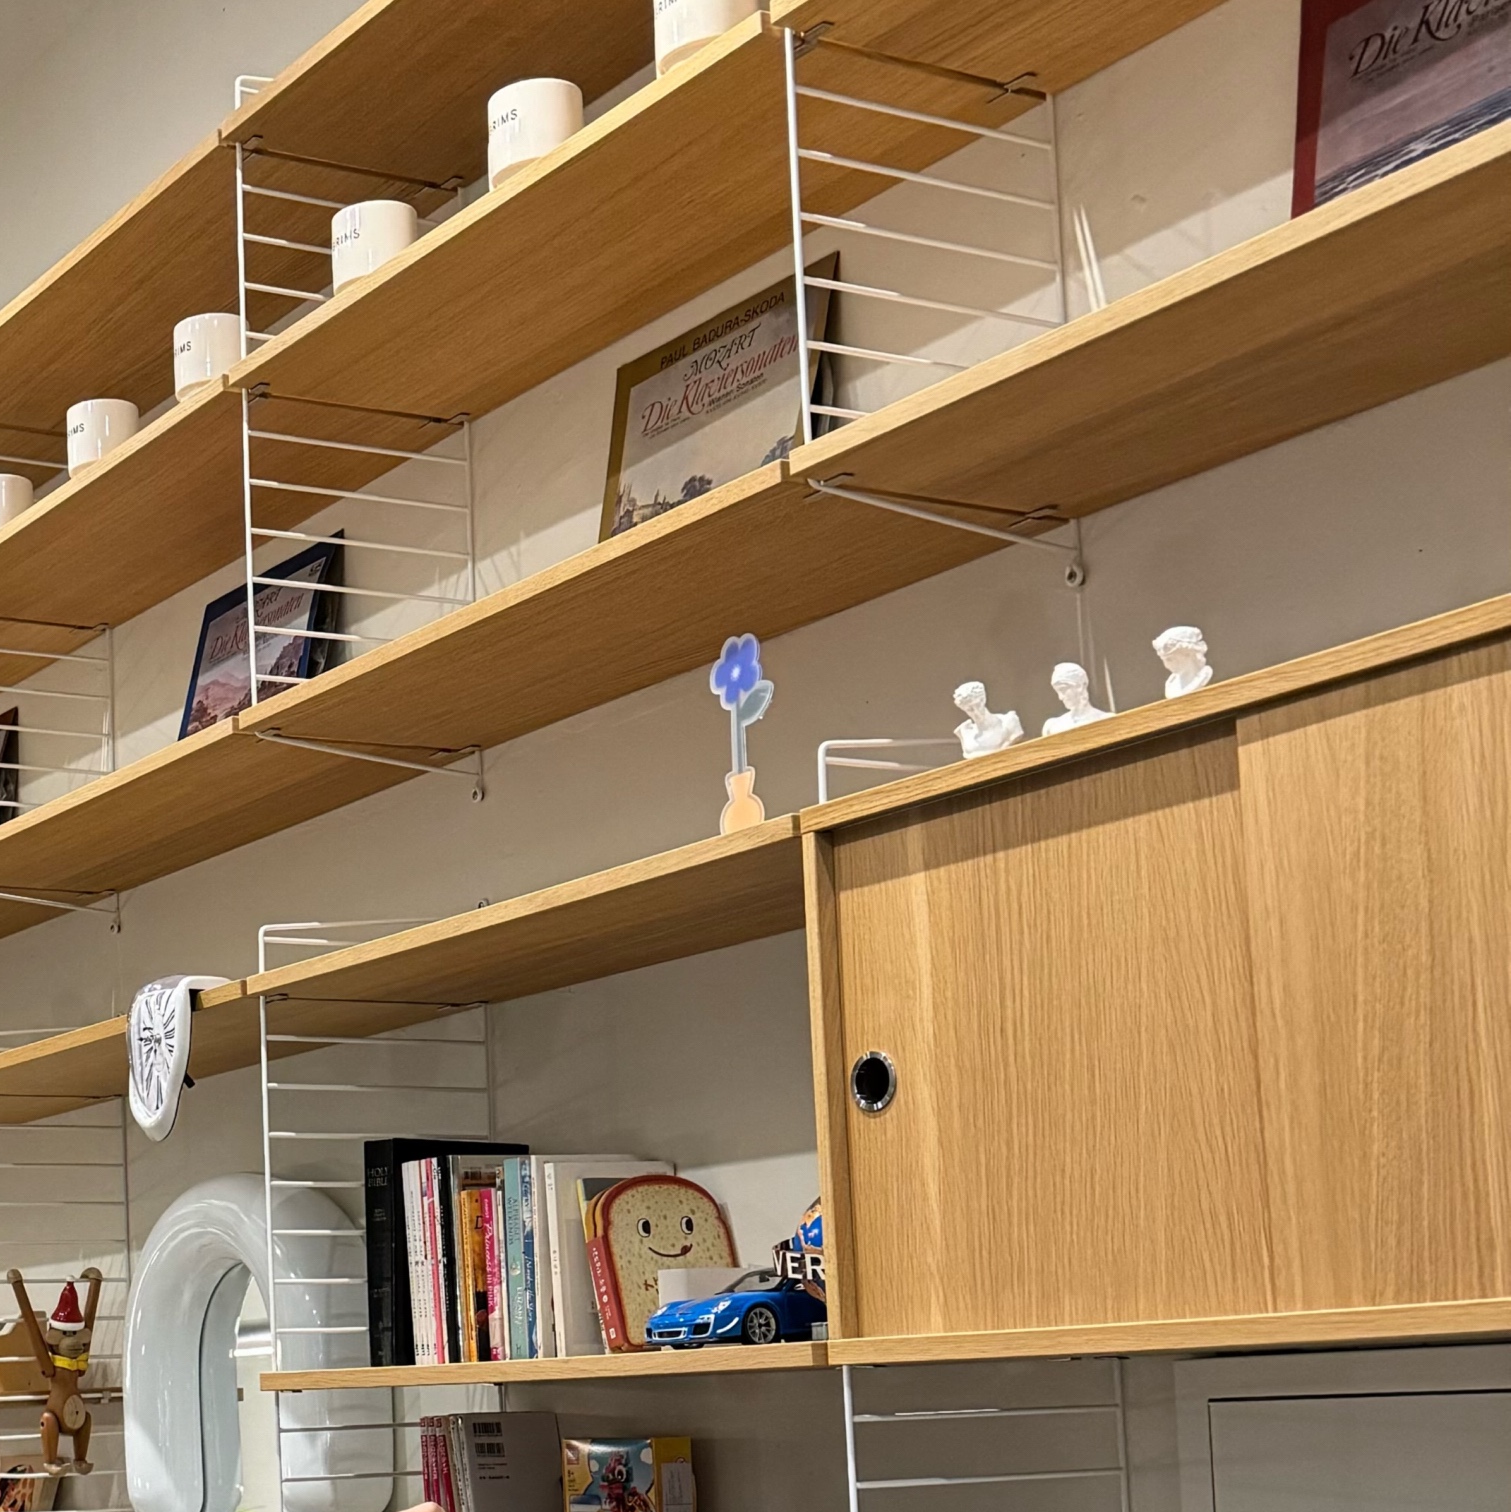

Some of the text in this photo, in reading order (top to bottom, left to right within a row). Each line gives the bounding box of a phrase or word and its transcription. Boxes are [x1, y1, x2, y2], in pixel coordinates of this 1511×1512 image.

[660, 291, 786, 369] PAUL BADURA-SKODA
[683, 322, 762, 382] MOZART
[641, 396, 678, 435] Die
